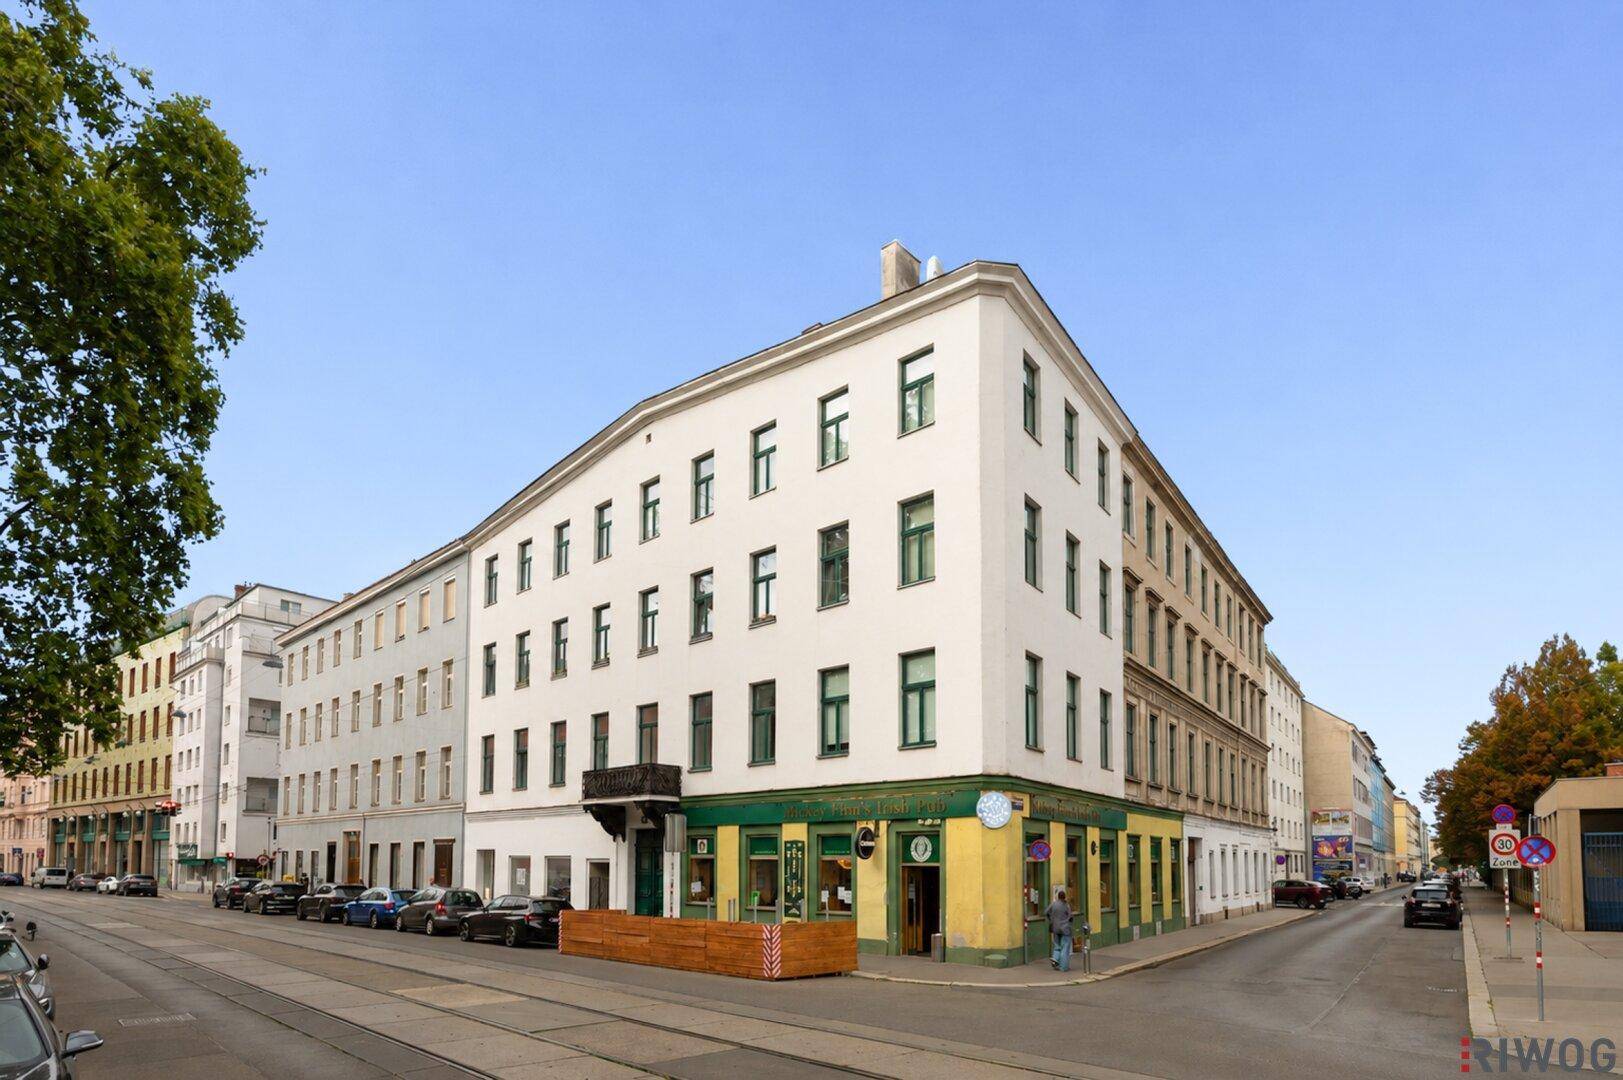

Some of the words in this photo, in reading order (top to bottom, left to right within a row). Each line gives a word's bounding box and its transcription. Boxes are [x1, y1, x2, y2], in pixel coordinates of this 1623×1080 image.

[916, 798, 947, 815] Pub
[1498, 839, 1512, 850] 30
[1492, 858, 1519, 867] Zone
